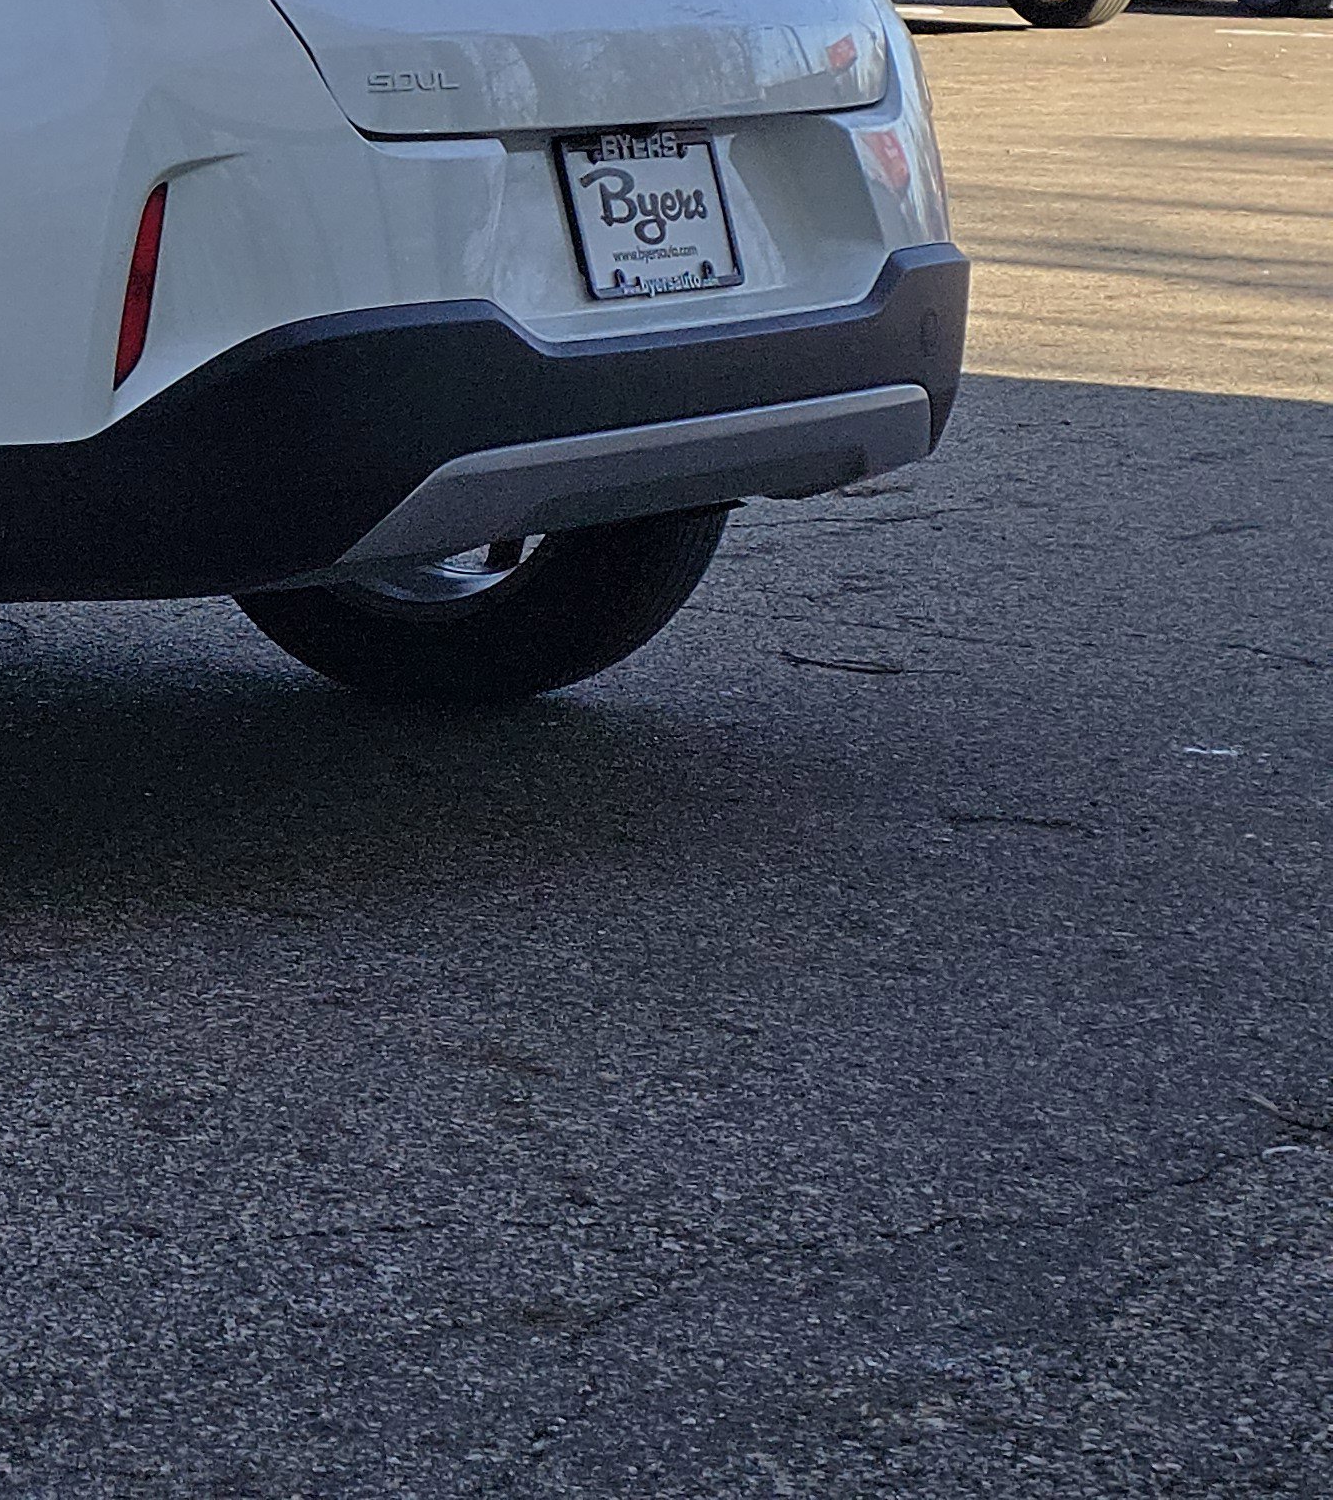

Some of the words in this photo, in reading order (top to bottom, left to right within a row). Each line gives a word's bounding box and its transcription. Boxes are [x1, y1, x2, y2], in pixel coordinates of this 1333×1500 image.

[366, 71, 460, 94] SOUL
[600, 131, 678, 161] BYERS
[578, 166, 708, 246] Byers
